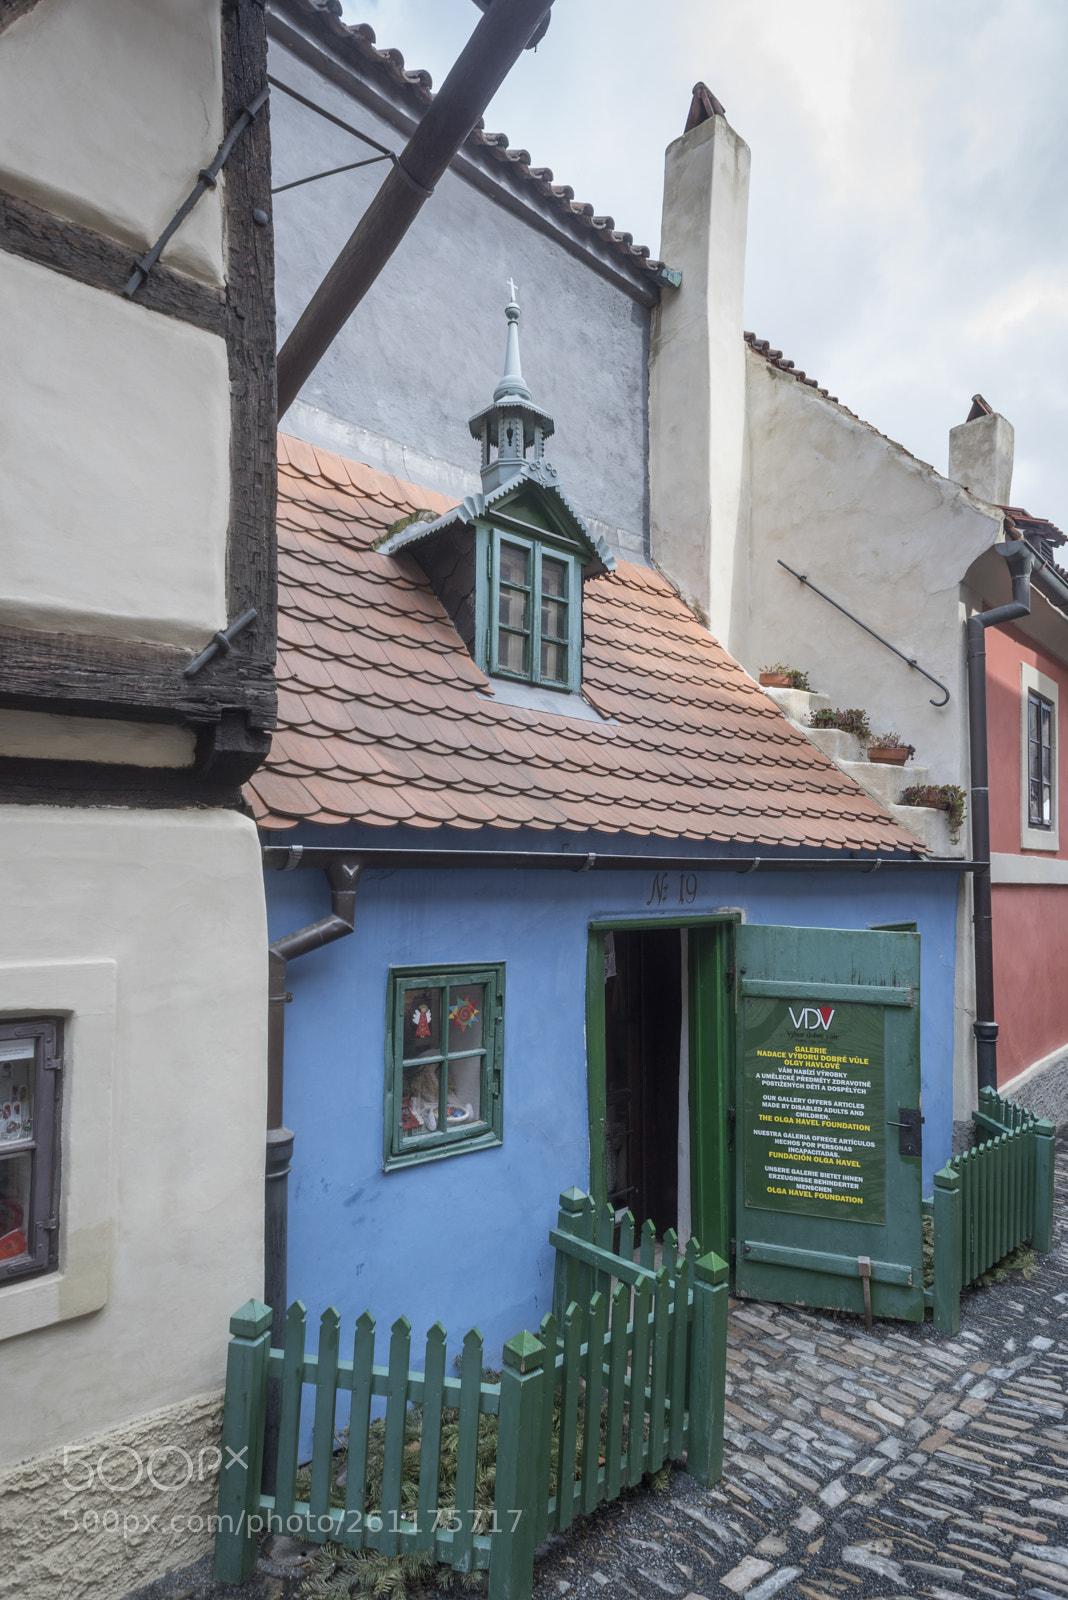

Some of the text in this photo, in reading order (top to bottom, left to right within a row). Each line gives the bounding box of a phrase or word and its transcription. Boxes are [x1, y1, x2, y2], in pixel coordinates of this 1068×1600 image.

[678, 873, 697, 904] 19
[788, 1006, 835, 1030] VDV
[795, 1046, 827, 1054] GALERIE
[757, 1050, 869, 1064] NADACE VÝBORU DOBRÉ VŮLE
[805, 1061, 840, 1069] HAVLOVÉ
[762, 1072, 794, 1081] UMĚLECKÉ
[816, 1070, 847, 1078] VÝROBKY
[762, 1080, 804, 1089] POSTIŽENÝCH
[791, 1104, 822, 1112] DISABLED
[833, 1101, 864, 1109] ARTICLES
[796, 1112, 830, 1120] CHILDREN.
[822, 1121, 870, 1131] FOUNDATION
[839, 1138, 875, 1147] ARTÍCULOS
[788, 1147, 840, 1158] INCAPACITADAS.
[817, 1144, 852, 1152] PERSONAS
[769, 1151, 861, 1167] FUNDACIÓN OLGA HAVEL
[791, 1169, 818, 1177] GALERIE
[820, 1172, 841, 1180] BIETET
[769, 1174, 859, 1189] ERZEUGNISSE BEHINDERTER
[796, 1184, 832, 1193] MENSCHEN
[767, 1186, 863, 1204] OLGA HAVEL FOUNDATION
